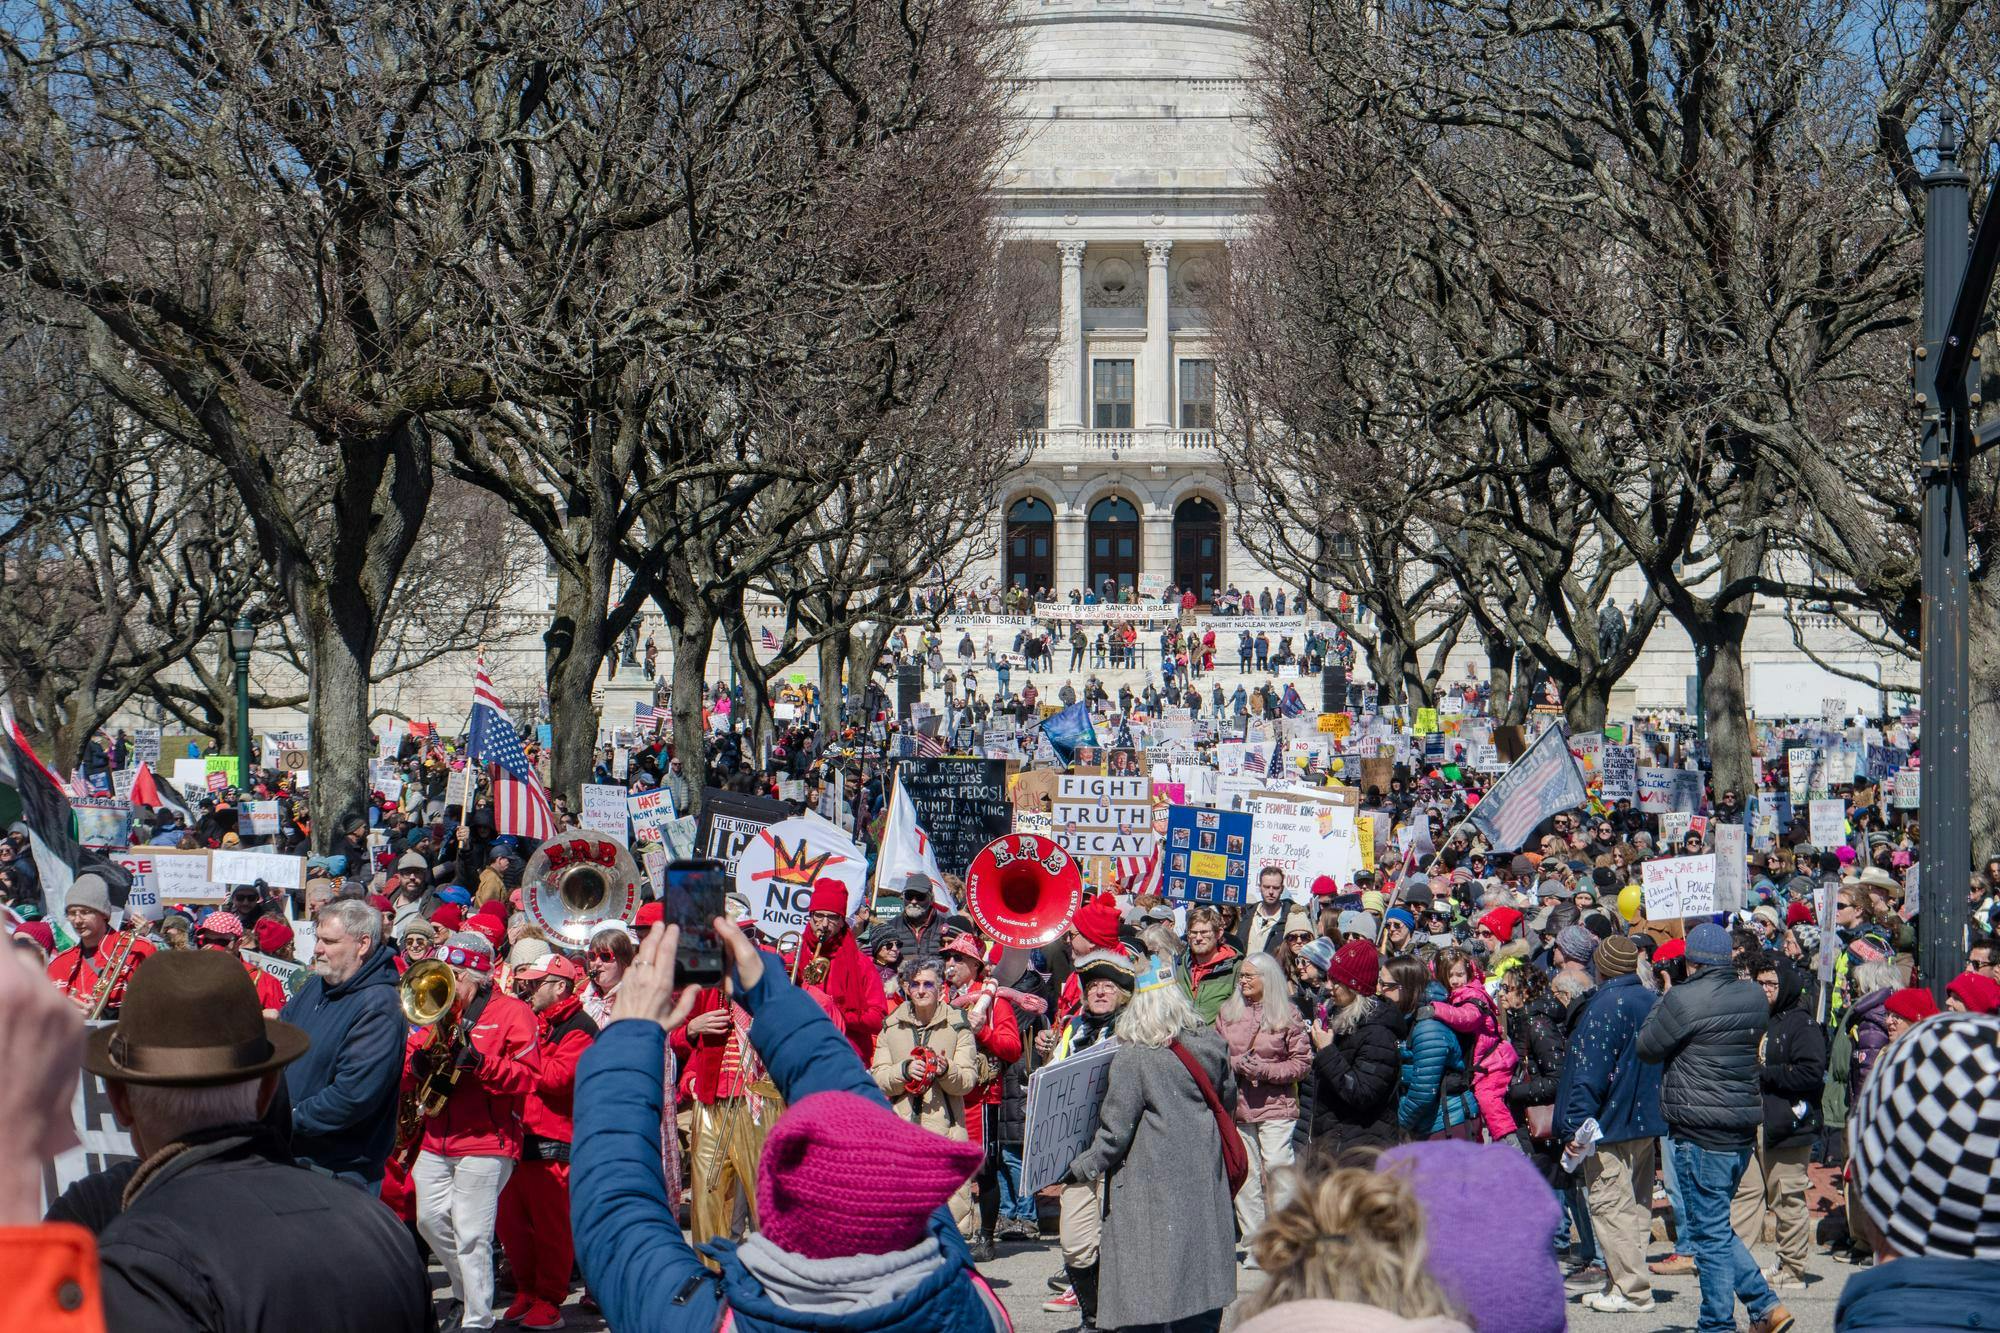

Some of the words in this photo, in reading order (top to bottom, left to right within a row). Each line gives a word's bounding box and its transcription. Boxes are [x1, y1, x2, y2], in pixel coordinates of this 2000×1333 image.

[1037, 604, 1070, 612] BOYCOTT
[1075, 604, 1100, 612] DIVEST
[1105, 604, 1143, 612] SANCTION
[1146, 604, 1172, 612] ISRAEL
[954, 615, 991, 625] ARMING
[996, 616, 1027, 625] ISRAEL
[1201, 621, 1232, 629] PROHIBIT
[1234, 621, 1266, 629] NUCLEAR
[1269, 620, 1302, 628] WEAPONS
[206, 760, 228, 771] STAND
[899, 760, 927, 774] THIS
[939, 762, 986, 775] REGIME
[1064, 779, 1142, 797] FIGHT
[117, 800, 131, 808] THE
[241, 802, 257, 813] WE
[583, 798, 595, 808] US
[637, 793, 661, 810] HATE
[1245, 800, 1262, 814] THE
[1300, 804, 1315, 817] KING
[655, 805, 673, 816] MAKE
[974, 802, 1005, 817] LYING
[1059, 807, 1145, 824] TRUTH
[649, 819, 661, 827] US
[716, 817, 732, 830] THE
[1017, 814, 1038, 824] KING
[637, 827, 661, 842] GRE
[1272, 833, 1288, 844] BUT
[712, 828, 746, 861] IC
[1056, 835, 1145, 852] DECAY
[1268, 842, 1281, 856] the
[543, 838, 617, 871] ERB
[987, 835, 1068, 877] ERB
[1259, 857, 1297, 871] REJECT
[1646, 864, 1665, 878] Stop
[1664, 866, 1674, 874] the
[1674, 861, 1694, 874] SAVE
[1687, 880, 1713, 894] POWE
[765, 882, 812, 912] NO
[1699, 894, 1712, 902] the
[970, 873, 1014, 943] EXTRAORDINARY
[1065, 889, 1079, 918] BAND
[1681, 897, 1711, 914] People
[762, 908, 811, 926] KINGS
[996, 914, 1029, 928] Providence,
[1046, 1072, 1081, 1116] THE
[1031, 1113, 1059, 1157] GOT
[1058, 1104, 1087, 1143] DUE
[1030, 1148, 1061, 1190] WHY
